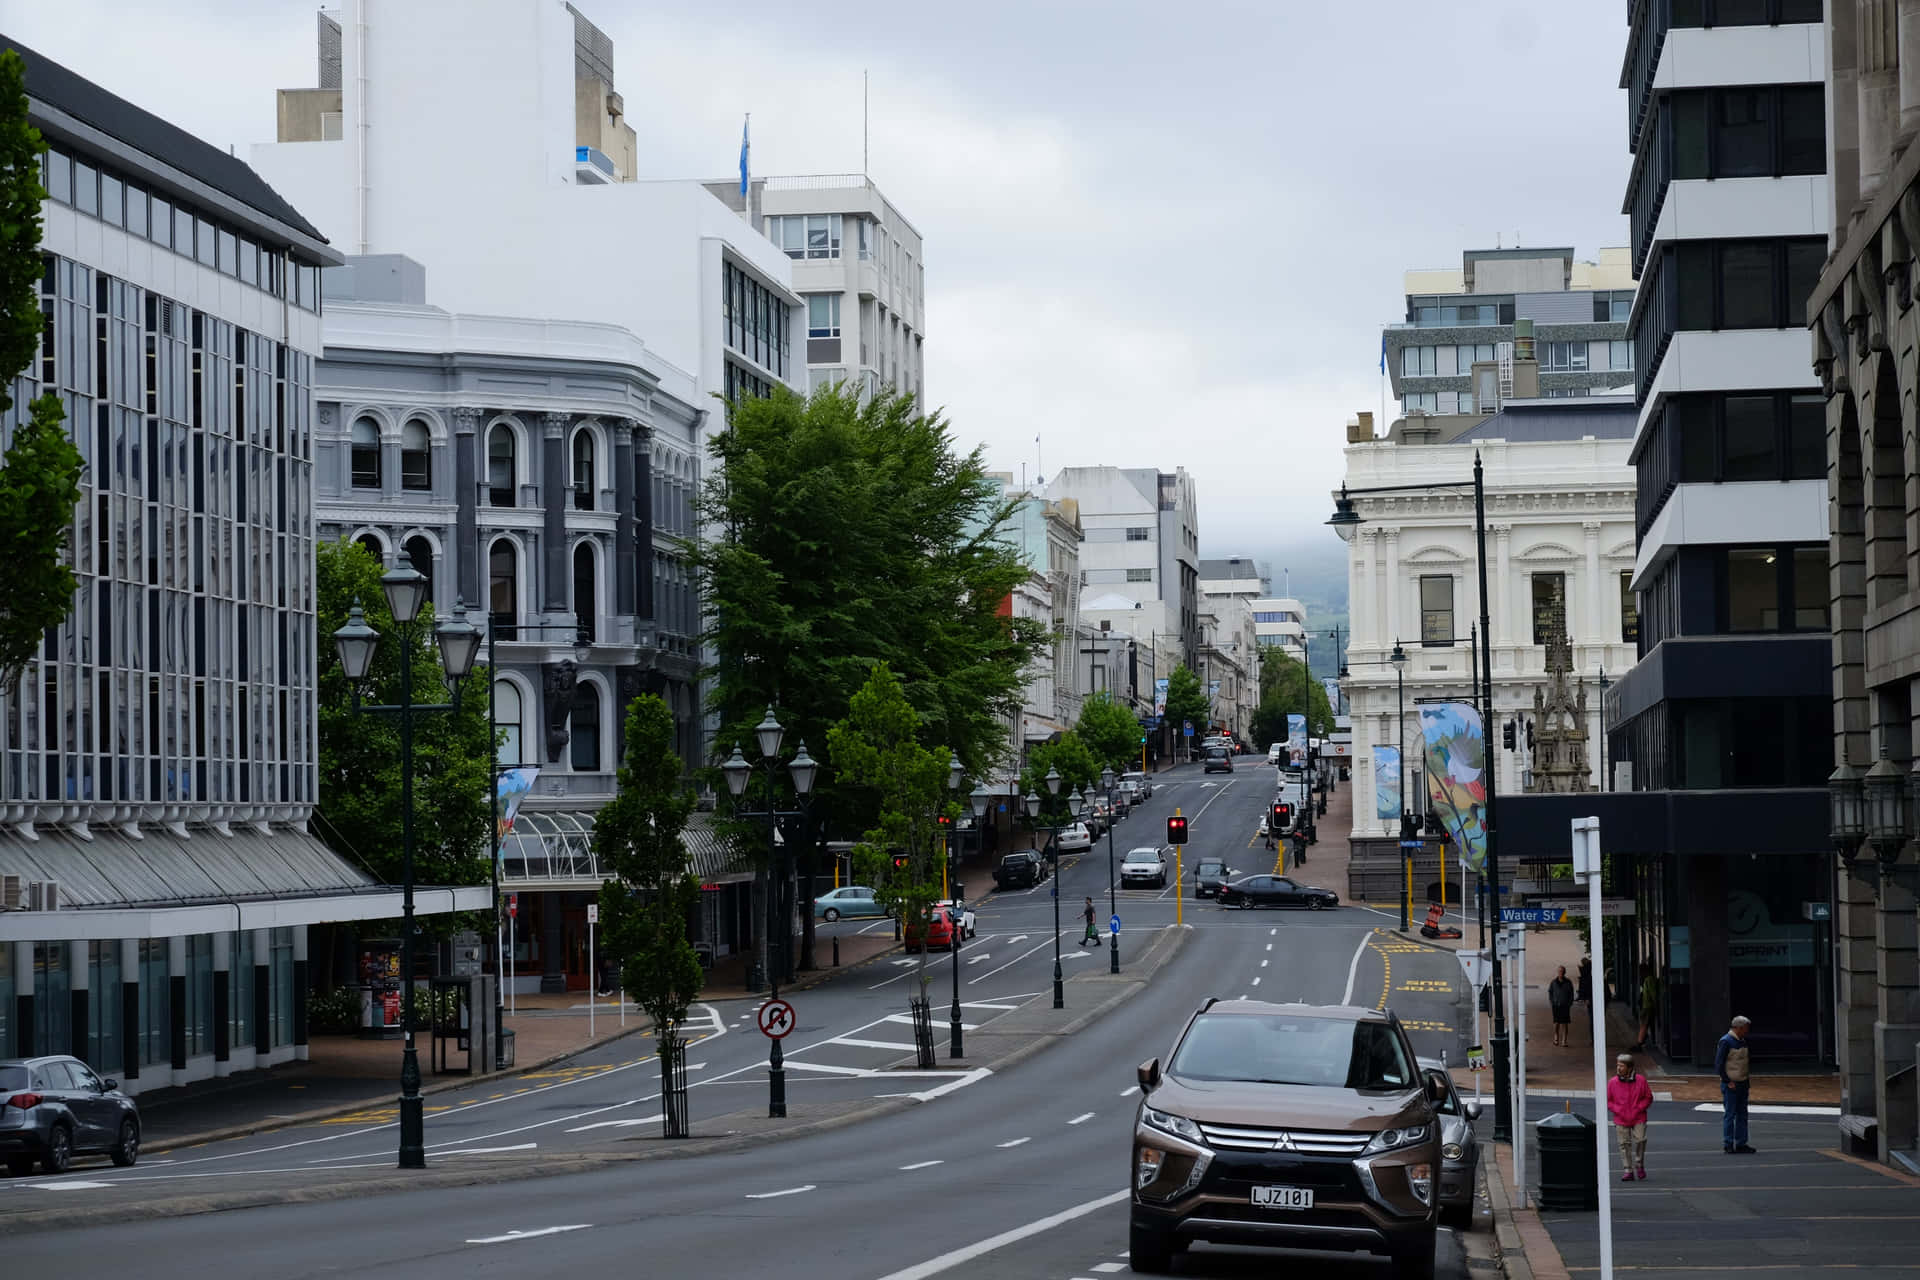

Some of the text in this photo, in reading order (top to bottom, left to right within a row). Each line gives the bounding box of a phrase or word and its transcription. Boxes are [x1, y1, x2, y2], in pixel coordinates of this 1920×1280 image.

[1503, 909, 1556, 921] Water St
[1253, 1188, 1309, 1206] LJZ101
